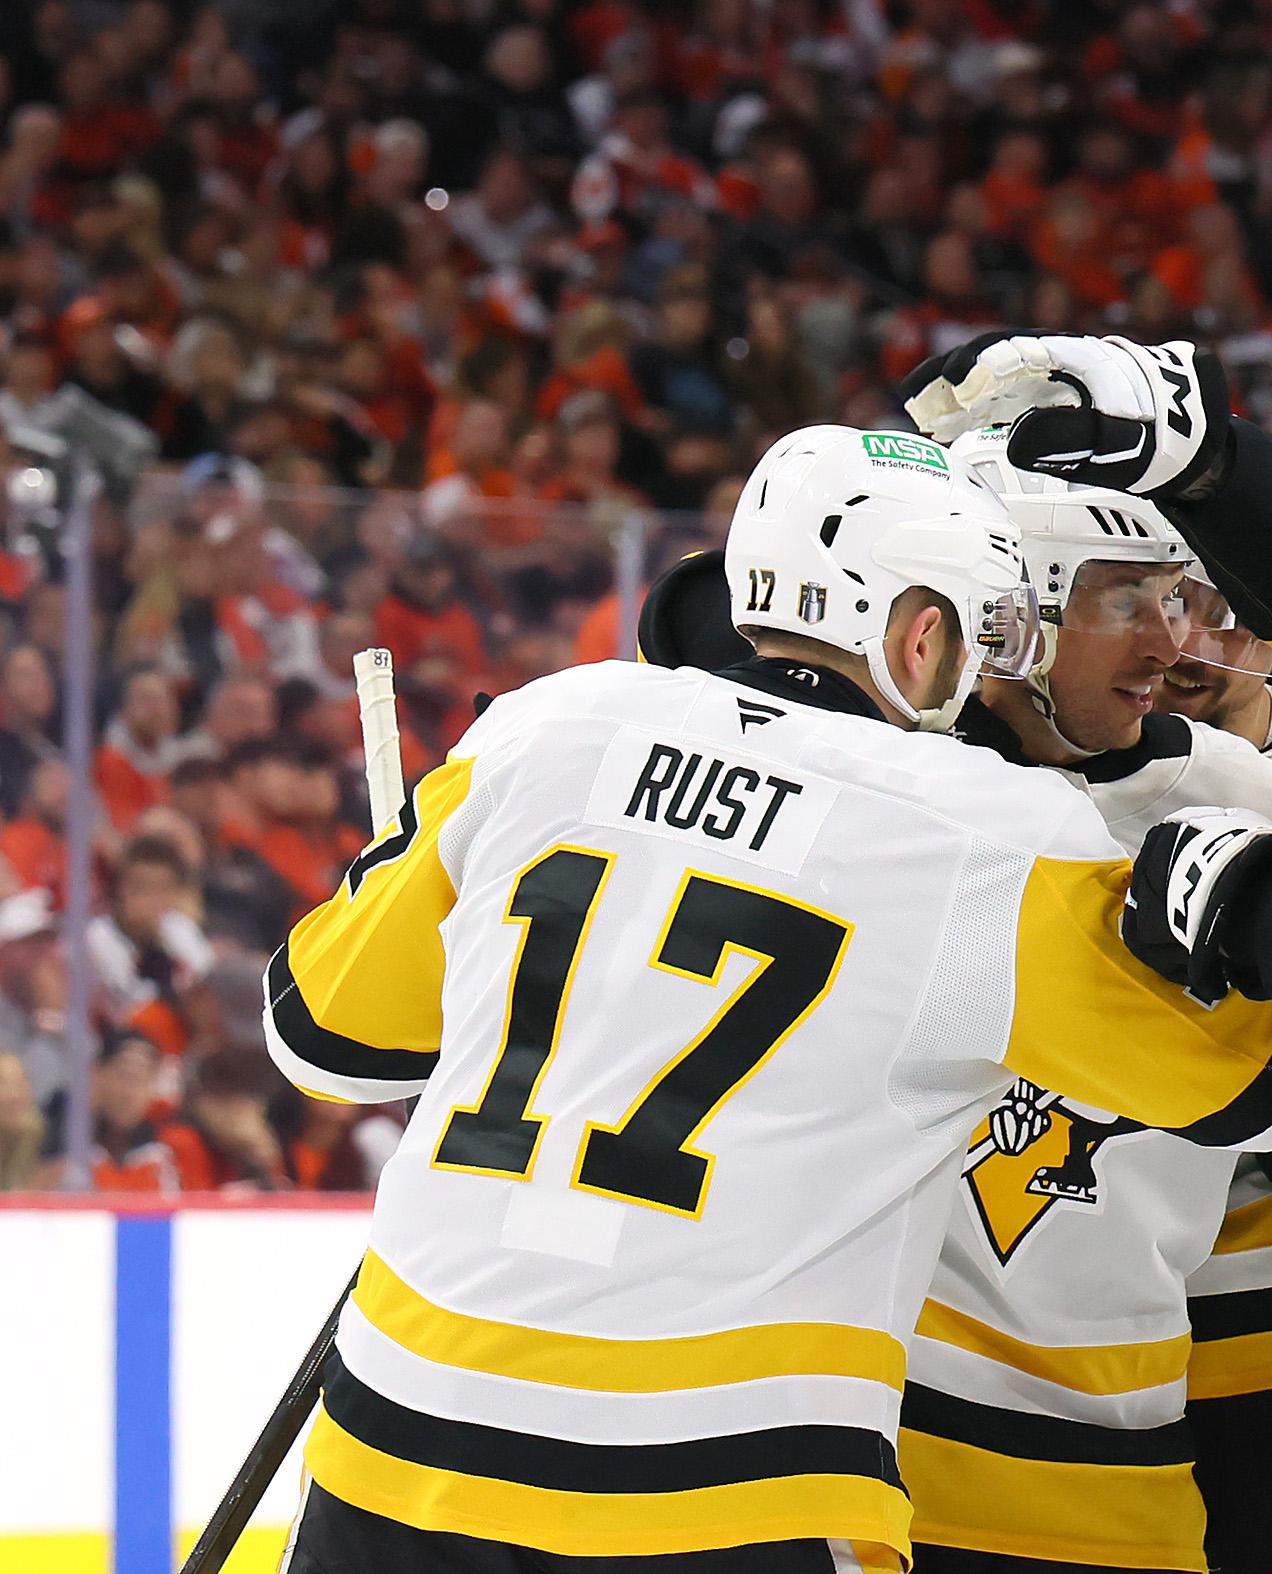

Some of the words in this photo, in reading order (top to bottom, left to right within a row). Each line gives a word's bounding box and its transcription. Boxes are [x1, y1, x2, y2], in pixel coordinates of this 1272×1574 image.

[865, 436, 948, 469] MSA
[871, 459, 887, 468] The
[888, 460, 914, 471] Safety
[915, 466, 951, 481] Company
[746, 567, 776, 612] 17
[374, 651, 389, 667] 87
[623, 742, 804, 852] RUST
[430, 844, 855, 1221] 17
